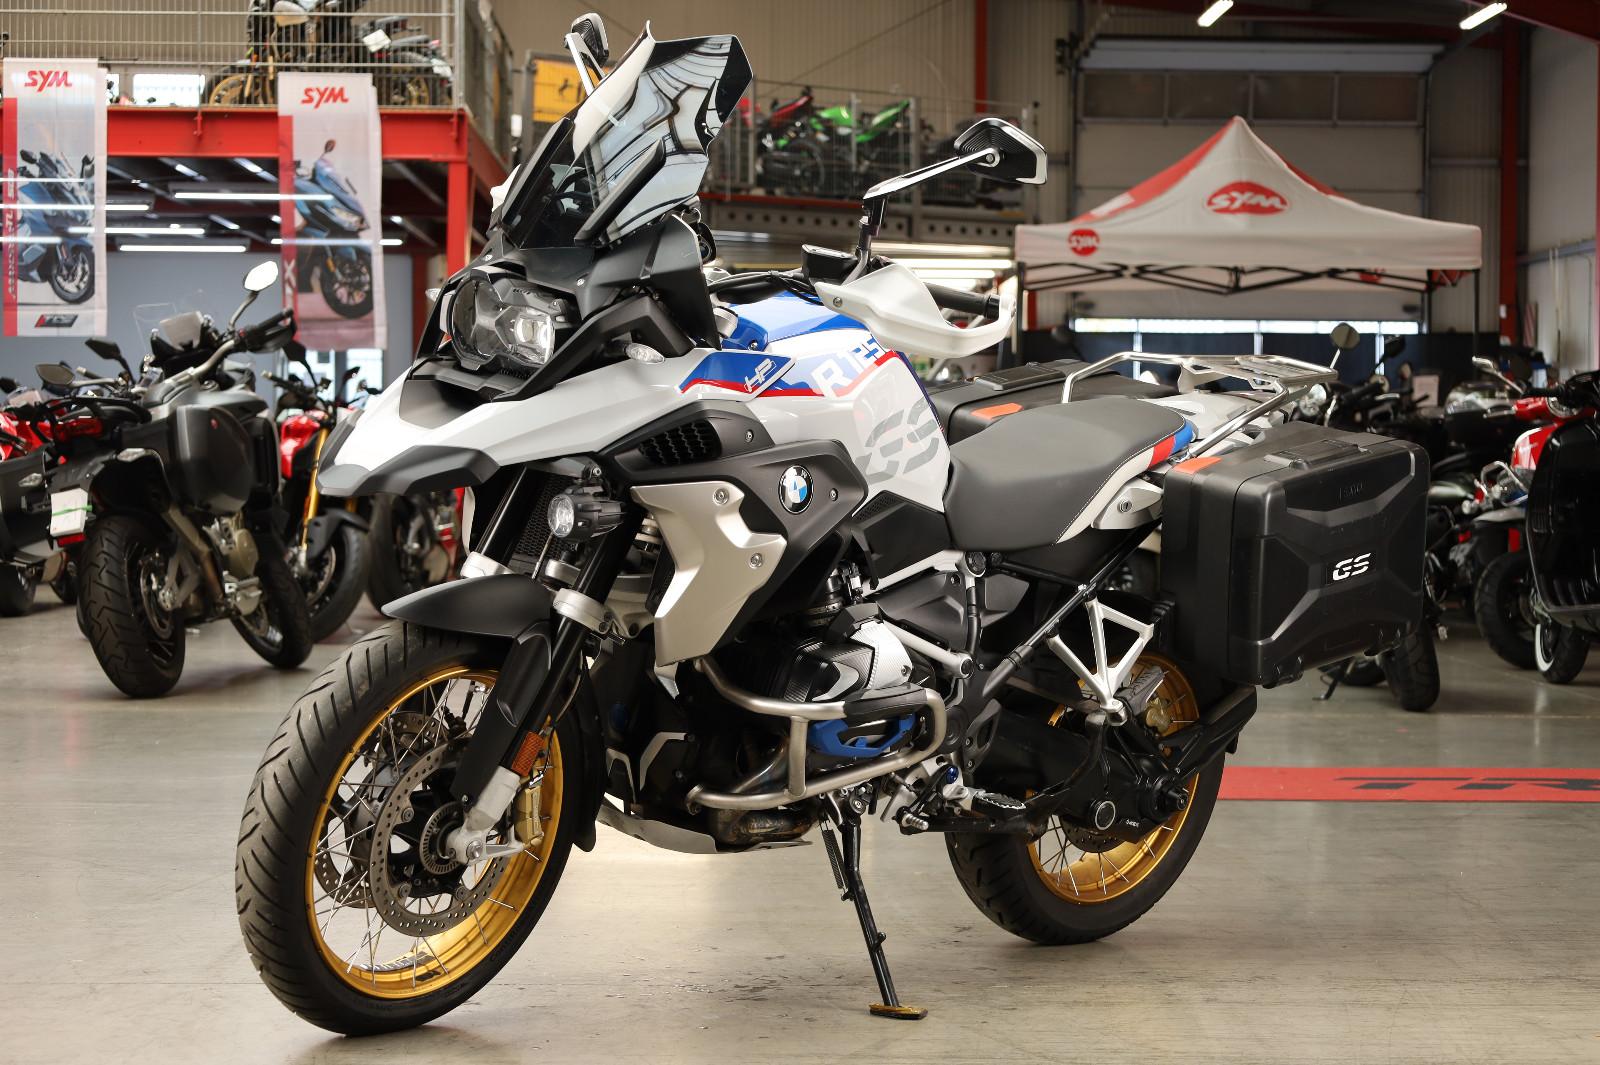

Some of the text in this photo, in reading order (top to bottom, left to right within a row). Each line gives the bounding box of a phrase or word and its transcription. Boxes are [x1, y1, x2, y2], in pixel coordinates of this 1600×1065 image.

[24, 70, 73, 93] SYM
[300, 86, 350, 110] SYM
[1210, 190, 1289, 211] SYM
[1332, 552, 1372, 581] GS
